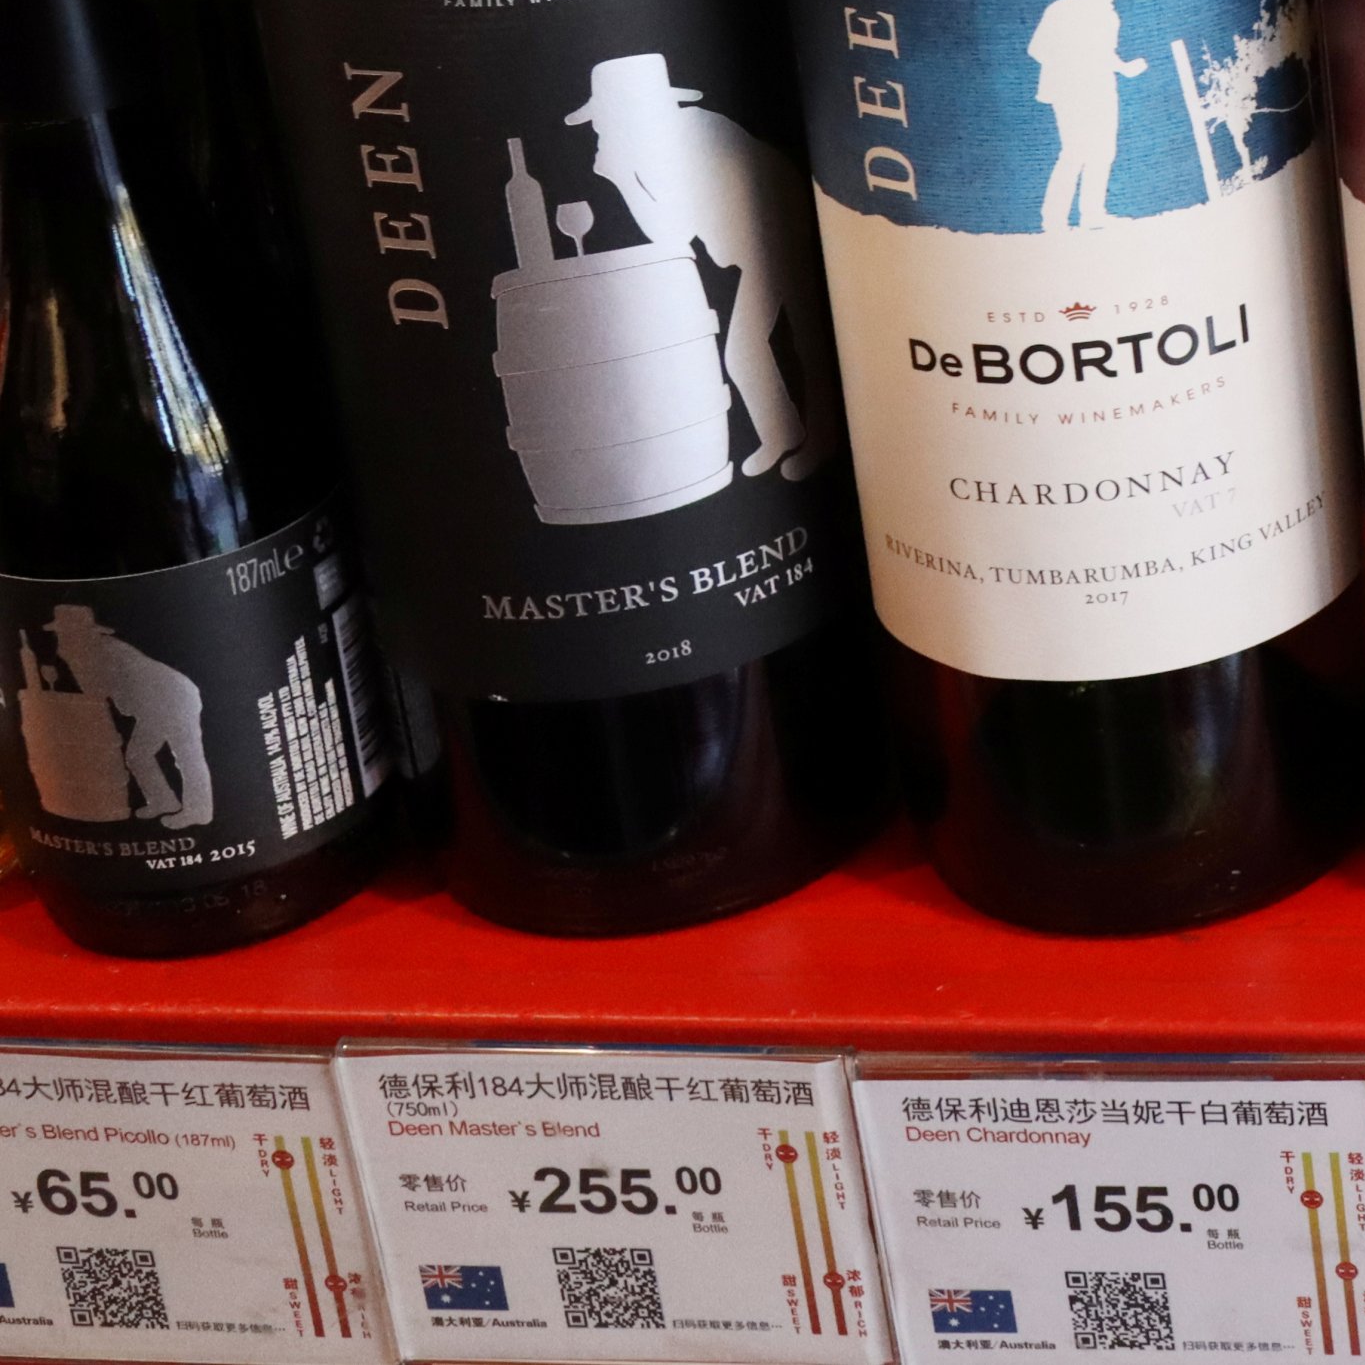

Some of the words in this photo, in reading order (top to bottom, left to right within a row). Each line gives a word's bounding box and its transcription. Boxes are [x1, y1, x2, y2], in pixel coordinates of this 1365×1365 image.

[343, 62, 449, 330] DEEN
[987, 311, 1046, 324] ESTD
[1114, 295, 1170, 315] 1928
[952, 402, 1039, 425] FAMILY
[1059, 376, 1227, 425] WINEMAKERS
[949, 450, 1236, 506] CHARDONNAY
[1172, 492, 1222, 519] VAT
[885, 534, 985, 584] RIVERINA,
[989, 561, 1184, 586] TUMBARUMBA,
[1190, 533, 1253, 567] KING
[1258, 490, 1327, 542] VALLEY
[482, 576, 679, 620] MASTER'S
[689, 527, 808, 595] BLEND
[733, 577, 780, 609] VAT
[786, 557, 814, 586] 184
[1086, 590, 1130, 606] 2017
[645, 639, 692, 665] 2018
[120, 837, 196, 857] BLEND
[146, 858, 177, 870] VAT
[180, 854, 202, 867] 184
[210, 840, 256, 863] 2015
[379, 1072, 815, 1108] 德保利184大师混酿干红葡萄酒
[386, 1102, 459, 1118] (750ml)
[901, 1097, 1328, 1128] 德保利迪恩莎当妮干白葡萄酒
[42, 1124, 100, 1144] Blend
[104, 1126, 171, 1146] Picollo
[175, 1131, 237, 1151] (187ml)
[388, 1120, 443, 1137] Deen
[542, 1121, 601, 1138] Blend
[905, 1127, 960, 1143] Deen
[966, 1127, 1091, 1148] Chardonnay
[399, 1173, 467, 1193] 零售价
[693, 1223, 729, 1235] Bottle
